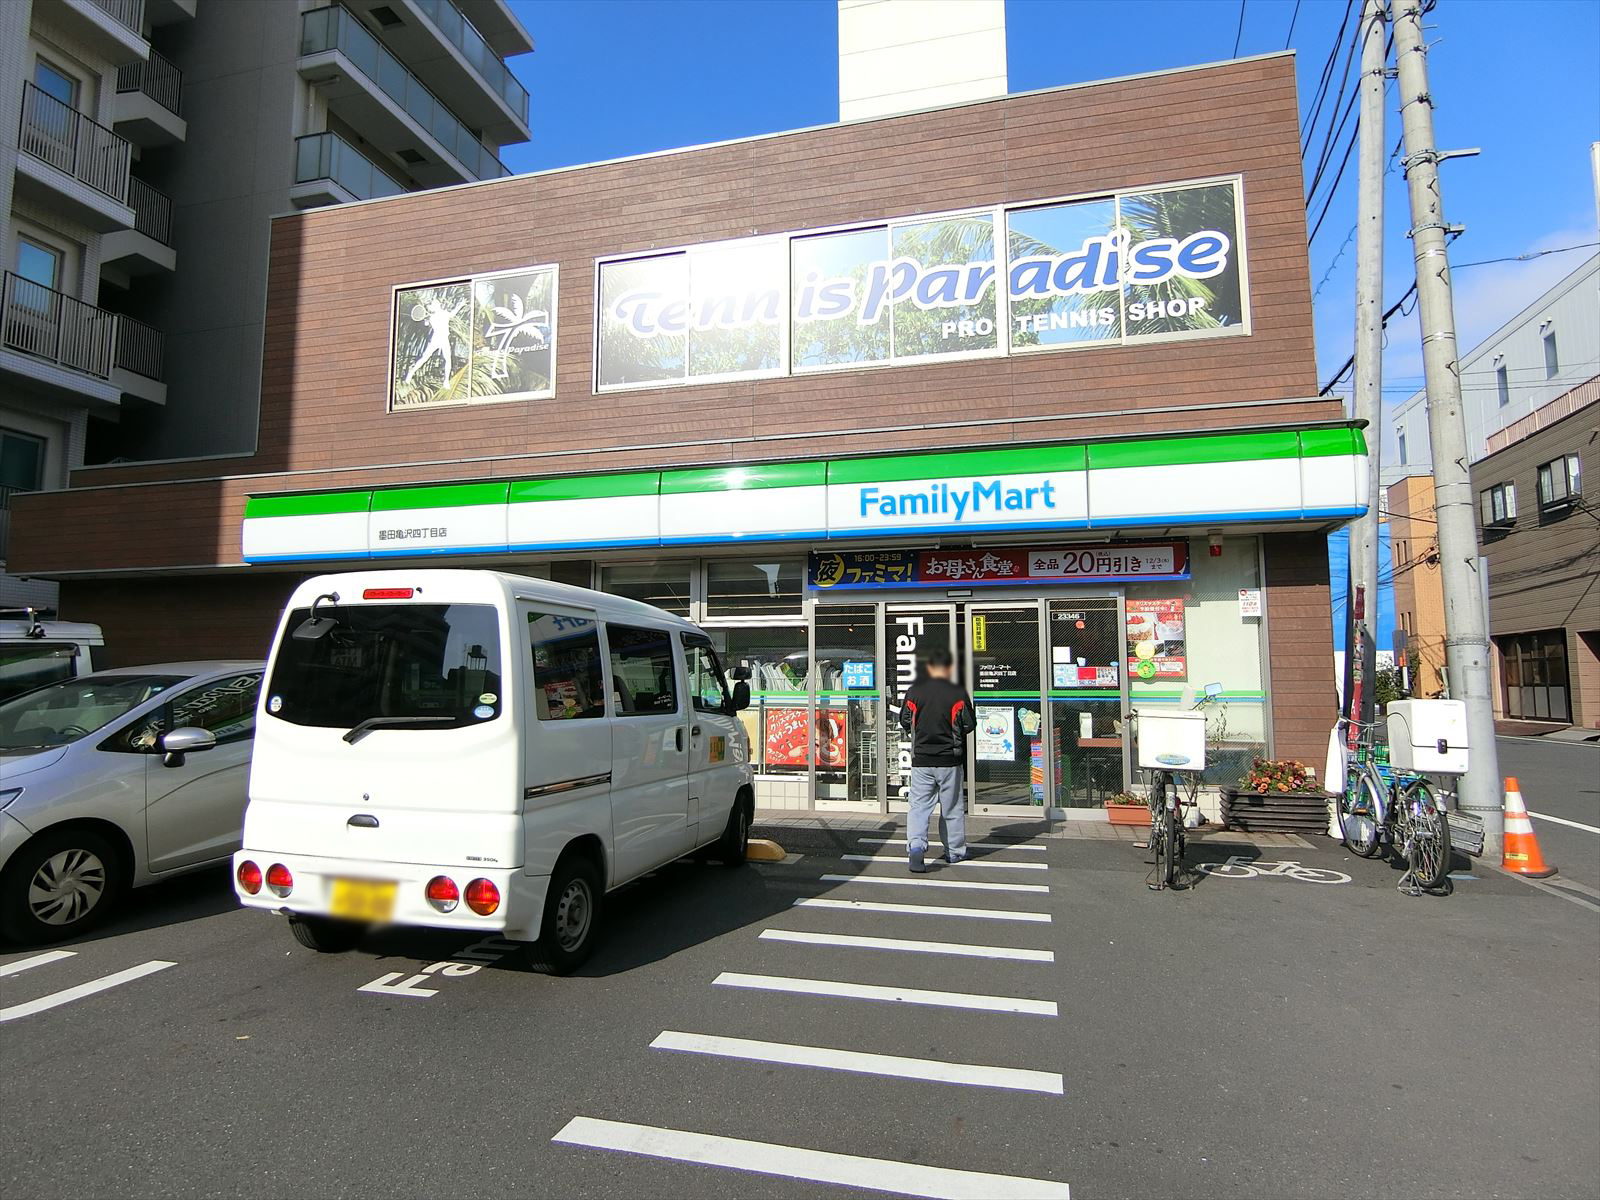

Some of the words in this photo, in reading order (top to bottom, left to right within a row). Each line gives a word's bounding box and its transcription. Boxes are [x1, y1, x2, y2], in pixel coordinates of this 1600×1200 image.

[610, 266, 853, 335] Tennis
[859, 227, 1227, 322] Paradise
[941, 318, 994, 340] PRO
[1015, 307, 1116, 333] TENNIS
[1128, 297, 1206, 321] SHOP
[507, 342, 550, 355] Paradise
[859, 479, 1056, 521] FamilyMart
[378, 527, 448, 541] 墨田亀沢四丁目店
[818, 559, 838, 582] 夜
[925, 552, 1014, 580] お母さん食堂
[1032, 558, 1059, 571] 全品
[843, 663, 873, 674] たばこ
